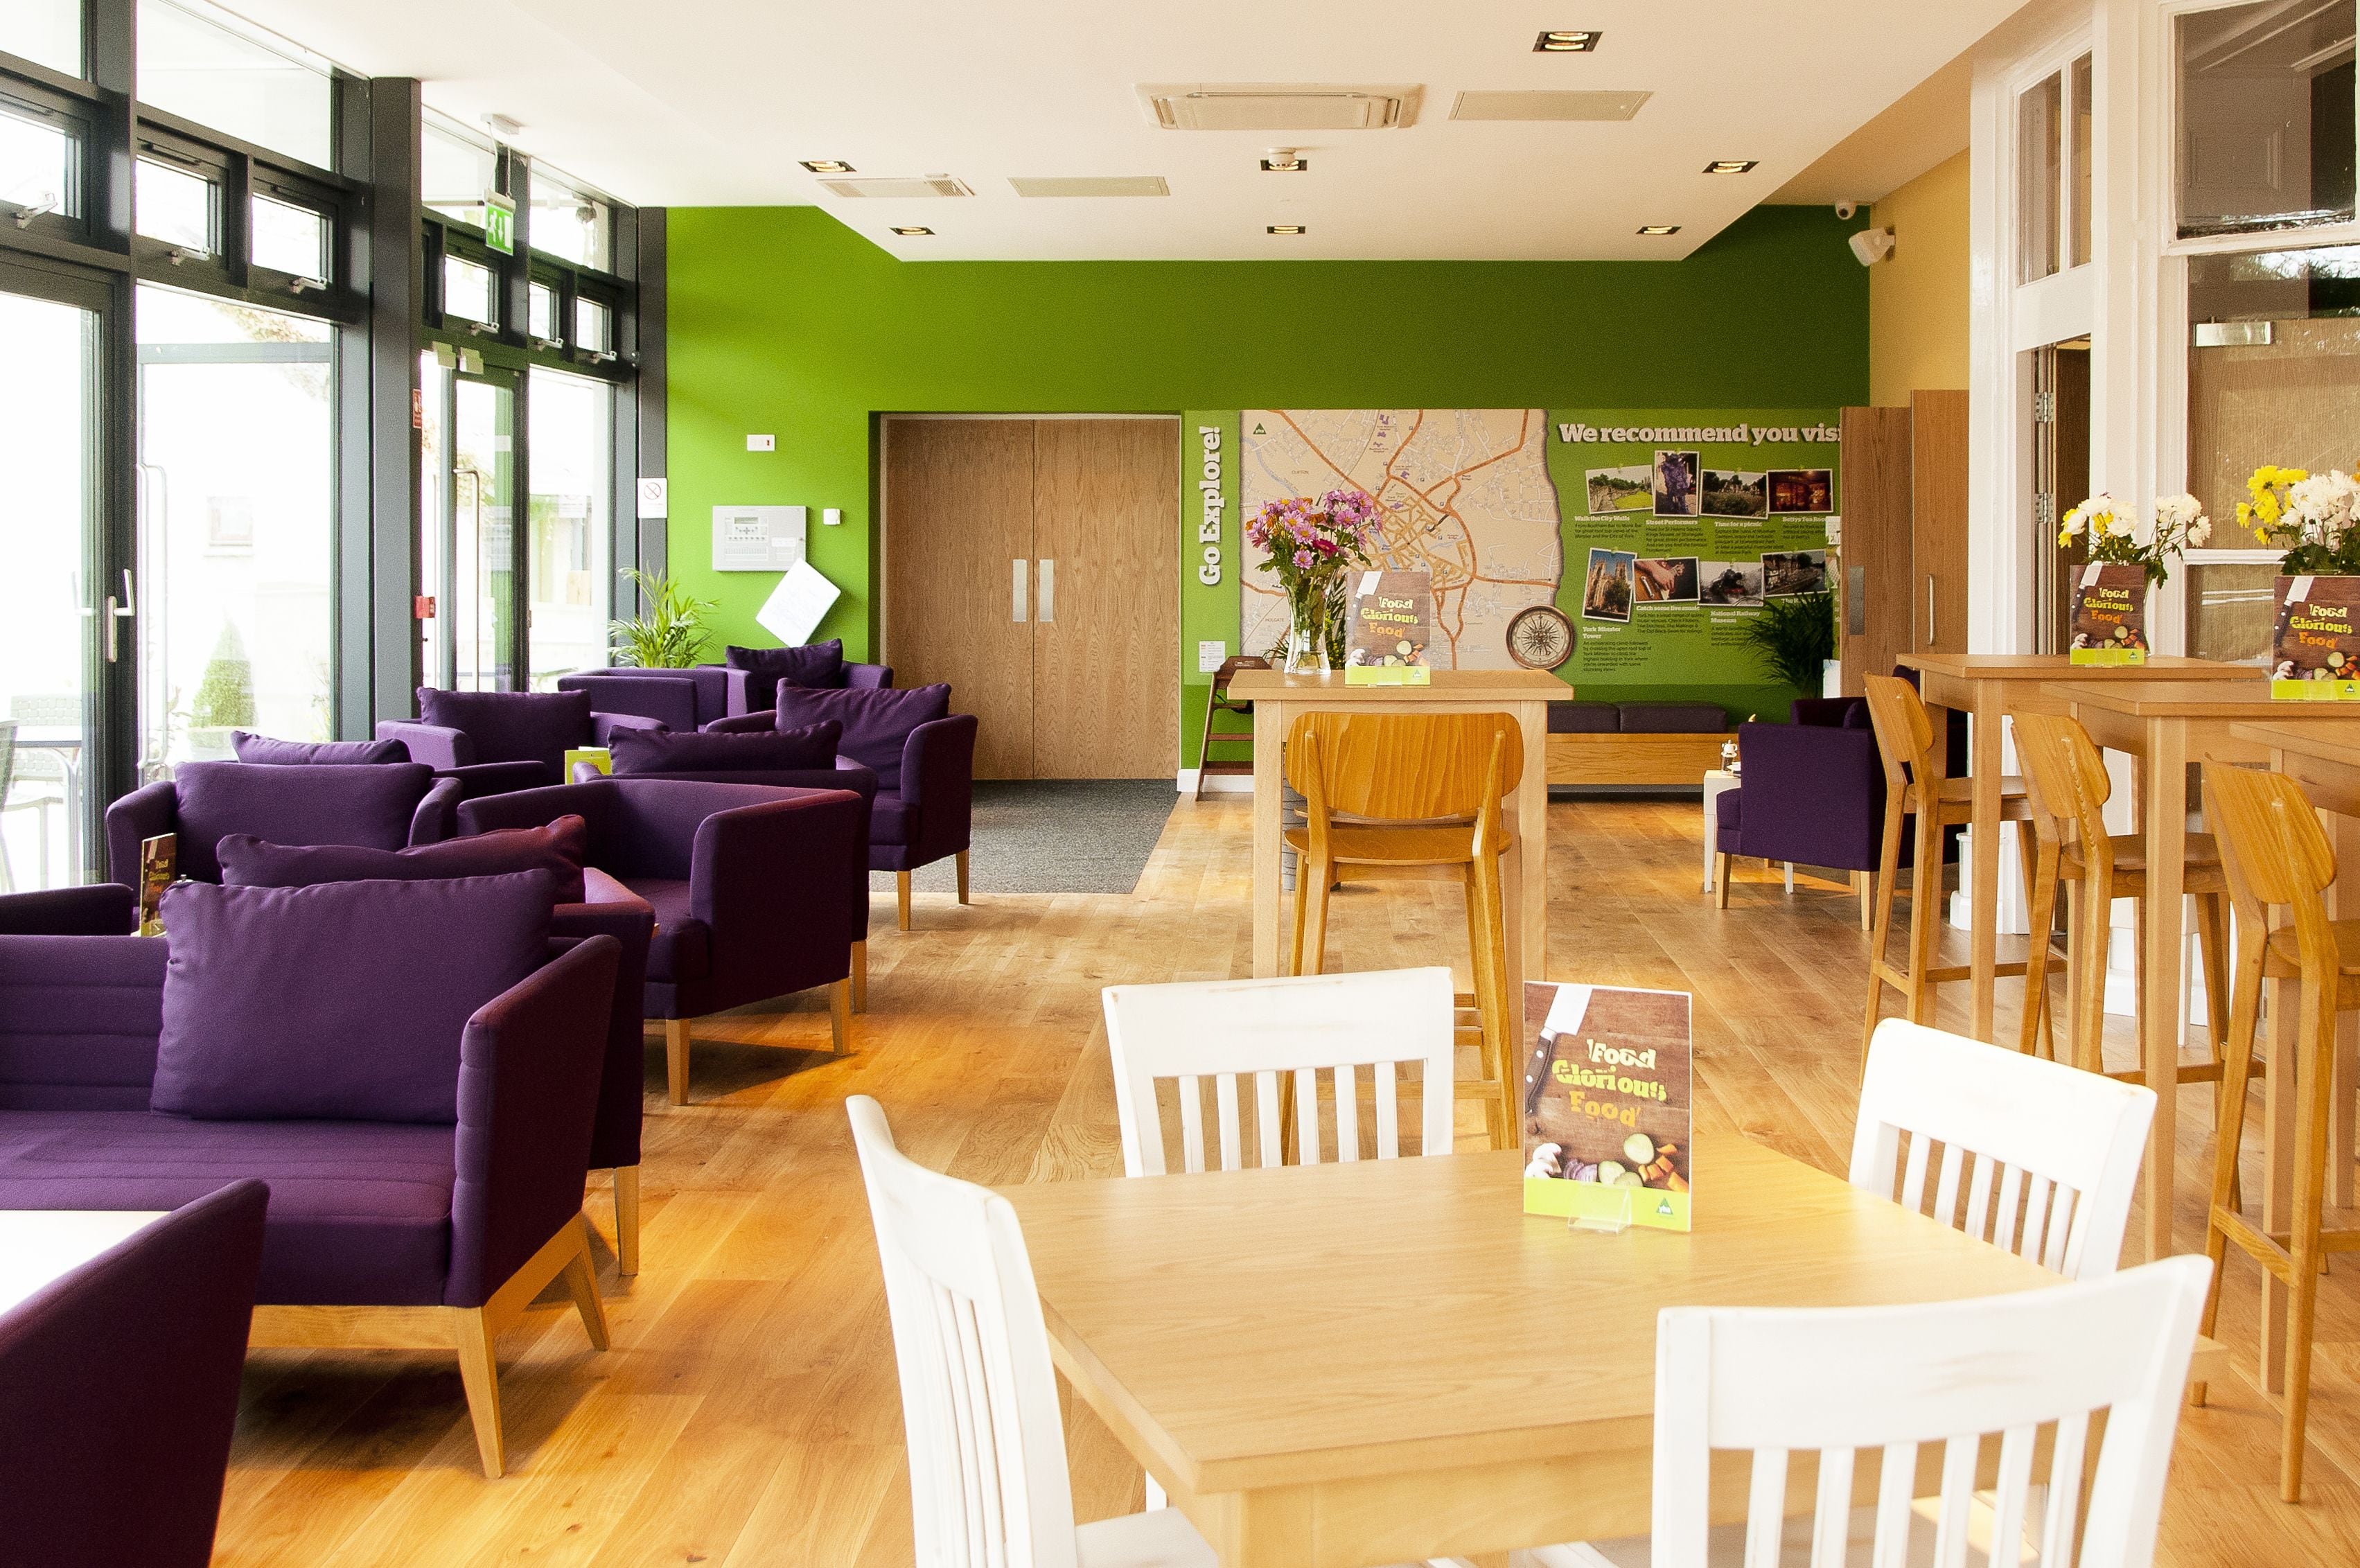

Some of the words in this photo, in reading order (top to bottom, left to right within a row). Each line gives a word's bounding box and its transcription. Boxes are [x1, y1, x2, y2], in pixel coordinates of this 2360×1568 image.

[1559, 423, 1598, 441] We
[1601, 423, 1747, 442] recommend
[1752, 427, 1798, 446] you
[1199, 425, 1224, 543] Explore!
[1199, 546, 1221, 585] Go
[2099, 588, 2129, 599] Food
[1378, 597, 1414, 609] Food
[2084, 597, 2133, 612] Glorious
[2309, 604, 2348, 618] Food
[1360, 608, 1418, 624] Glorious
[2091, 610, 2122, 624] Food
[2289, 615, 2352, 634] Glorious
[1369, 622, 1405, 637] Food
[2299, 631, 2339, 649] Food
[1586, 1039, 1657, 1070] Food
[1551, 1059, 1667, 1102] Glorious
[1569, 1091, 1641, 1127] Food
